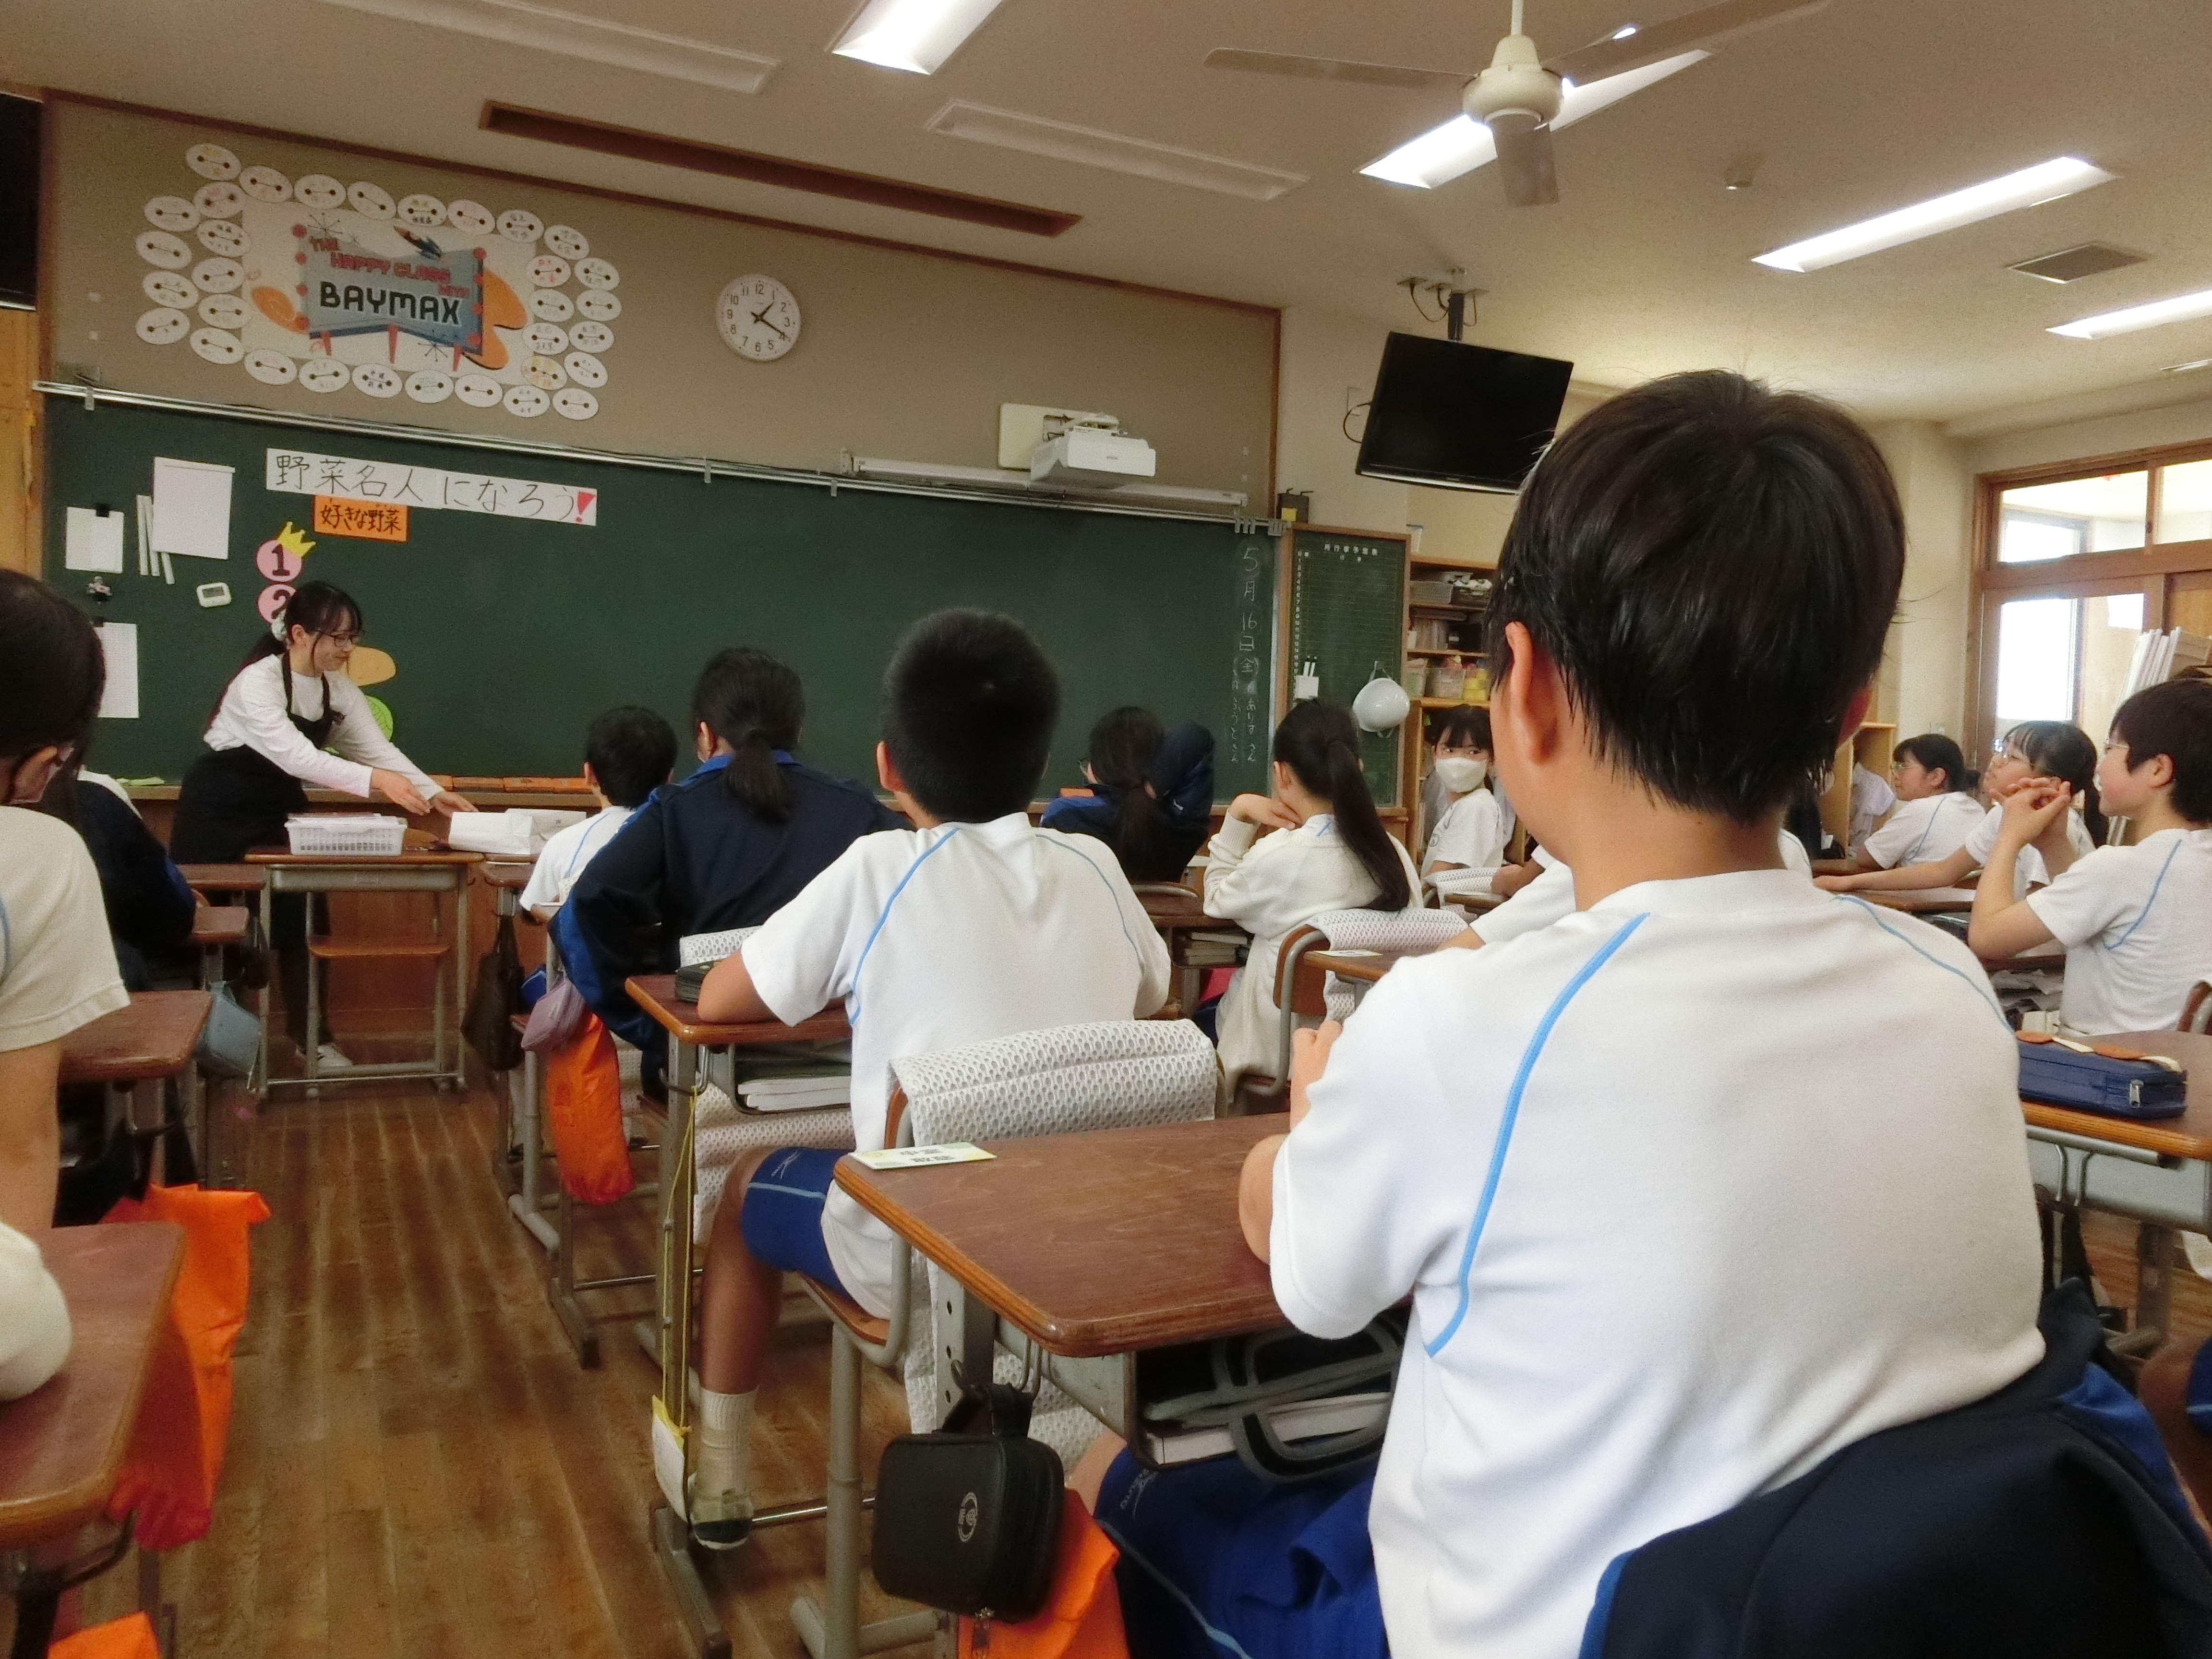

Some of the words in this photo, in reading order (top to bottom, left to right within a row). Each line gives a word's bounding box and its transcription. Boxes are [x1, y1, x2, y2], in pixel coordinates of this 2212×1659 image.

[743, 287, 749, 296] 11
[756, 284, 764, 295] 12
[320, 281, 459, 326] BAYMAX
[730, 294, 739, 305] 10
[781, 302, 786, 313] 2
[727, 309, 733, 319] 9
[784, 317, 790, 327] 3
[730, 325, 736, 335] 8
[743, 336, 749, 347] 7
[755, 342, 761, 352] 6
[768, 340, 774, 350] 5
[320, 505, 402, 535] 好きな野菜
[272, 543, 290, 576] 1
[1247, 743, 1257, 762] さん
